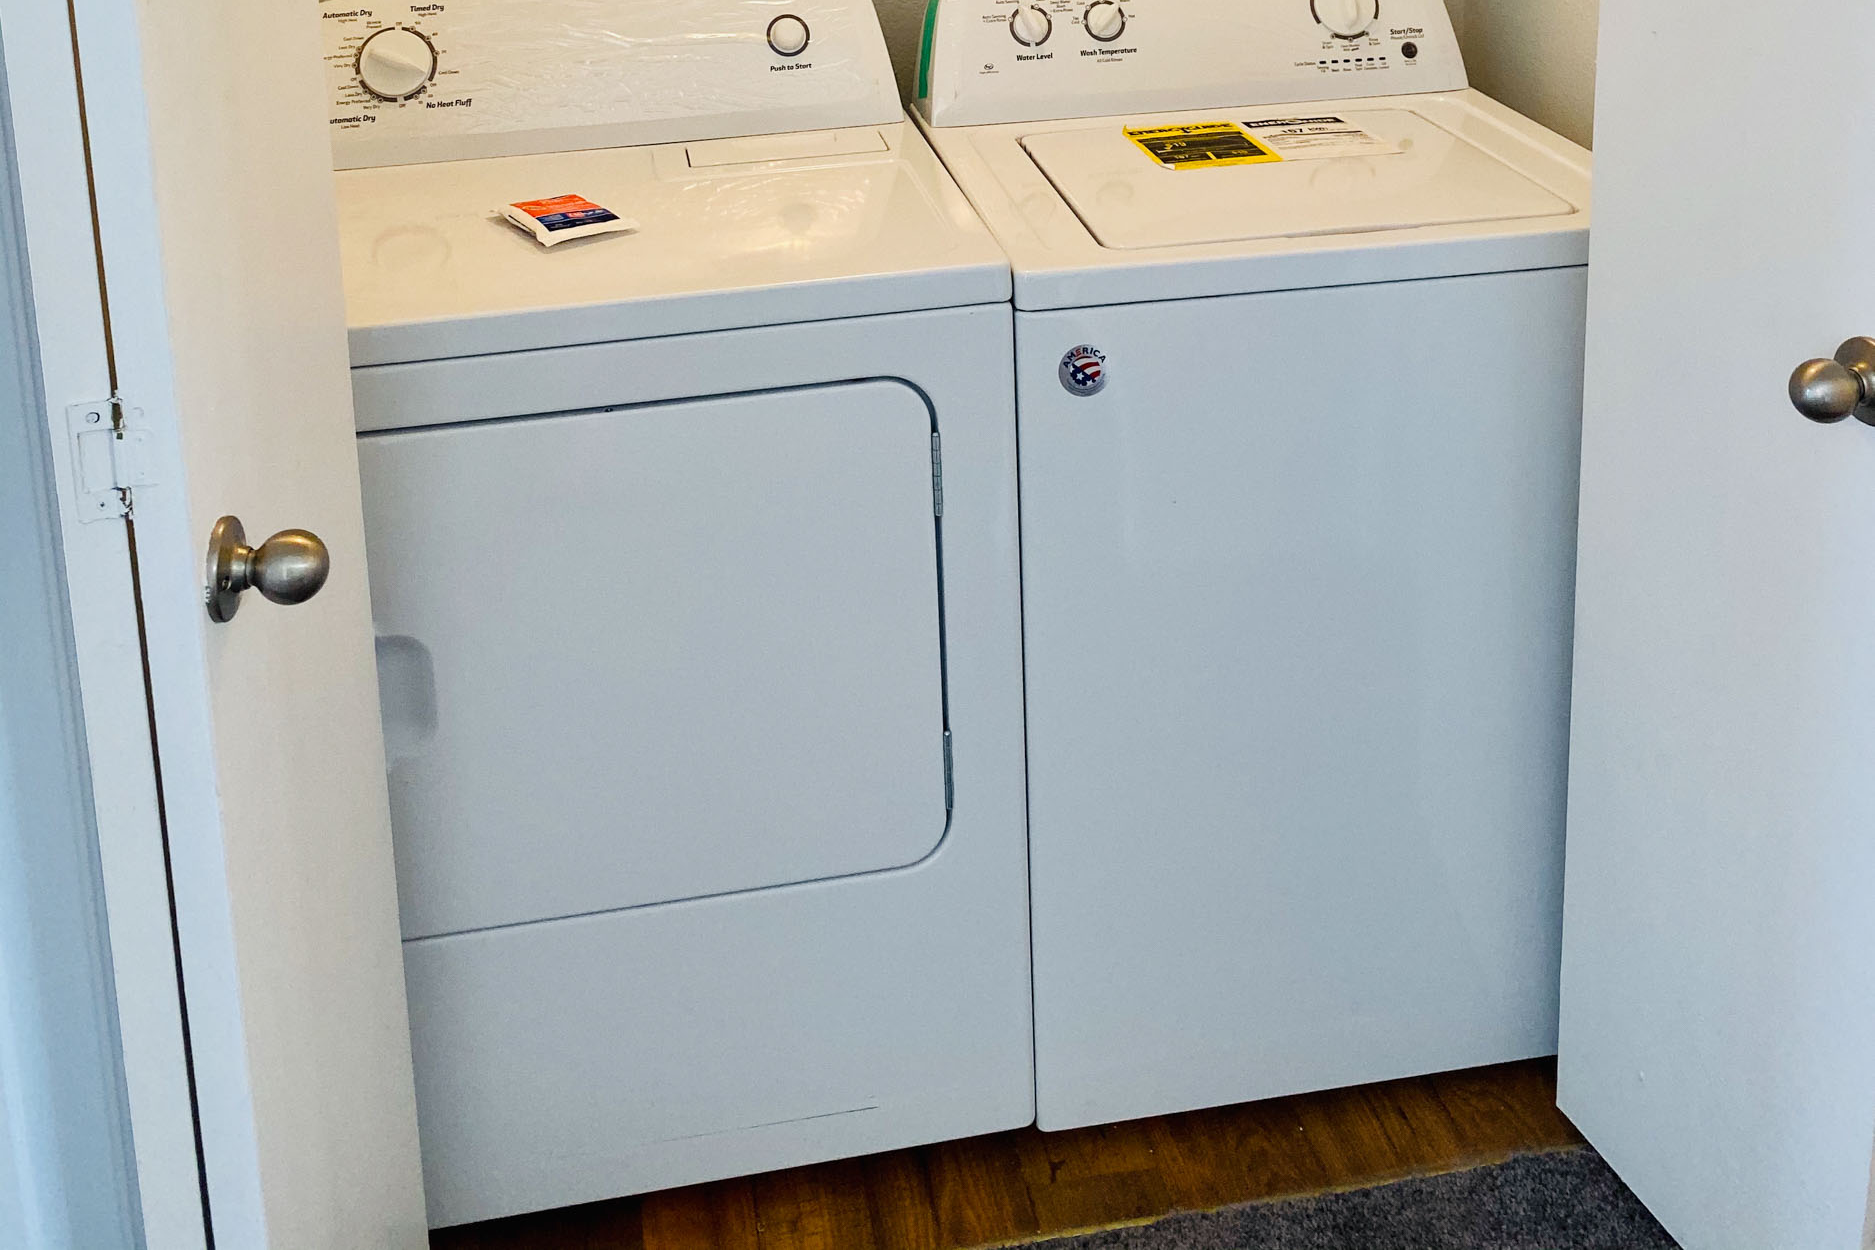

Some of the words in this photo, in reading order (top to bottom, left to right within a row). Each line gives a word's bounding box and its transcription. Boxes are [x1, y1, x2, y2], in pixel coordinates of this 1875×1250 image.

[410, 4, 432, 12] Timed
[431, 4, 445, 12] Dry
[322, 10, 359, 19] Automatic
[359, 9, 373, 18] Dry
[1016, 53, 1035, 61] Water
[1036, 52, 1053, 60] Level
[1097, 48, 1137, 56] Temperature
[770, 64, 786, 72] Push
[795, 62, 812, 70] Start
[436, 100, 454, 108] Heat
[454, 98, 473, 107] Fluff
[329, 116, 361, 124] utomatic
[362, 114, 376, 123] Dry
[1062, 347, 1106, 368] AMERICA
